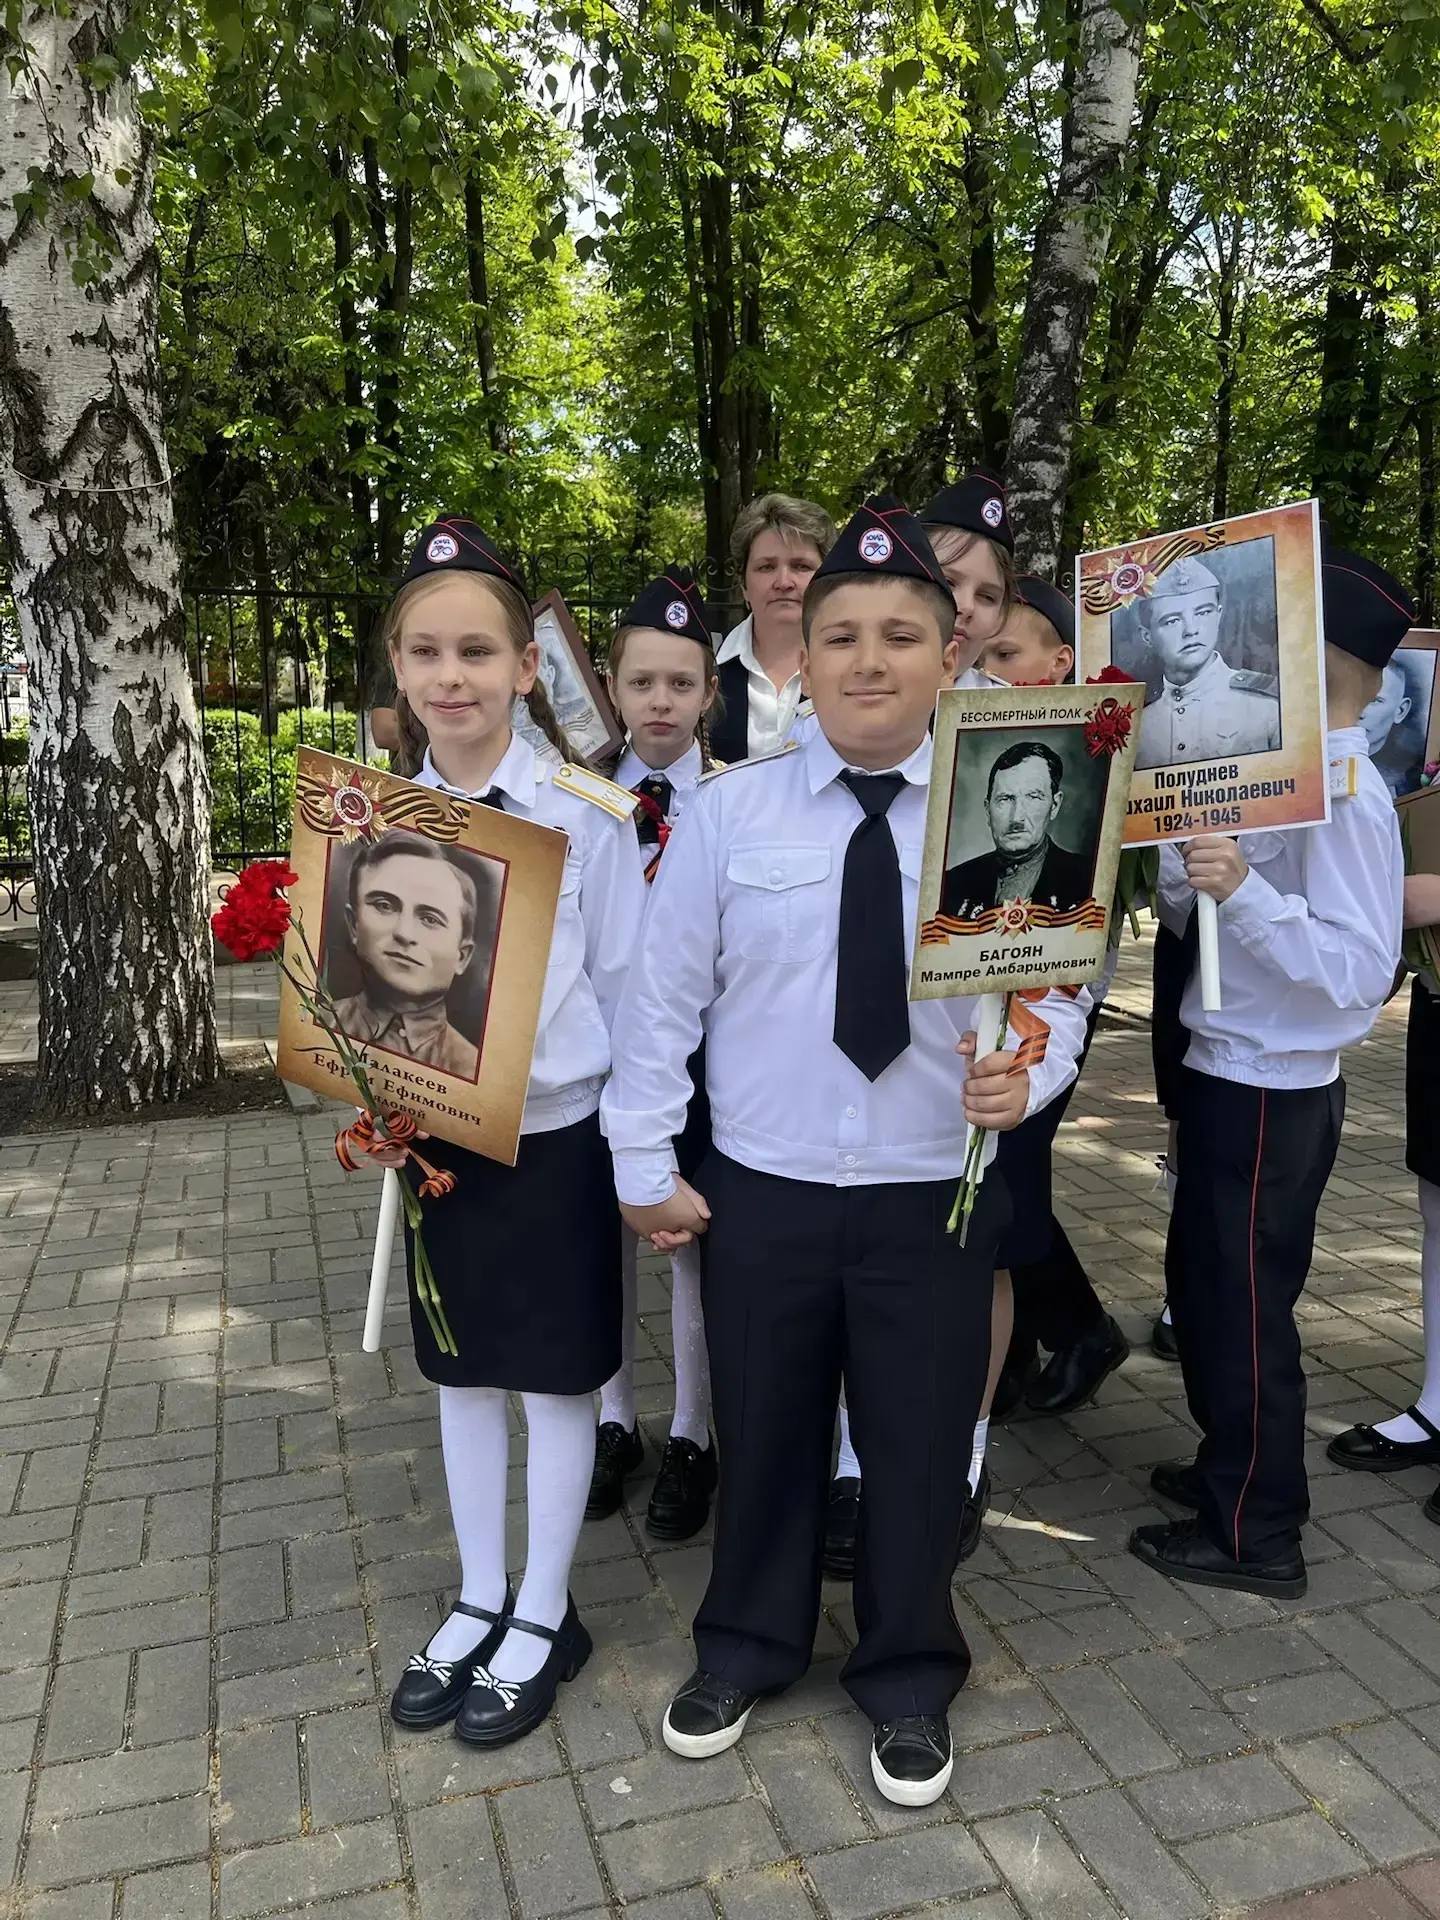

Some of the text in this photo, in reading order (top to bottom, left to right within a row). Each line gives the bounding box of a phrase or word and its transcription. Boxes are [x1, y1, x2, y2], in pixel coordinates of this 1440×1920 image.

[961, 707, 1082, 722] БЕССМЕРТНЫЙ ПОЛК
[1154, 764, 1239, 789] Полуднев
[1126, 778, 1295, 815] ихаил Николаевич
[1153, 806, 1241, 833] 1924-1945
[979, 945, 1043, 962] БАГОЯН
[921, 957, 1096, 983] Мампре Амбарцумович
[374, 1095, 427, 1121] ядовой
[383, 1079, 481, 1127] Ефимович
